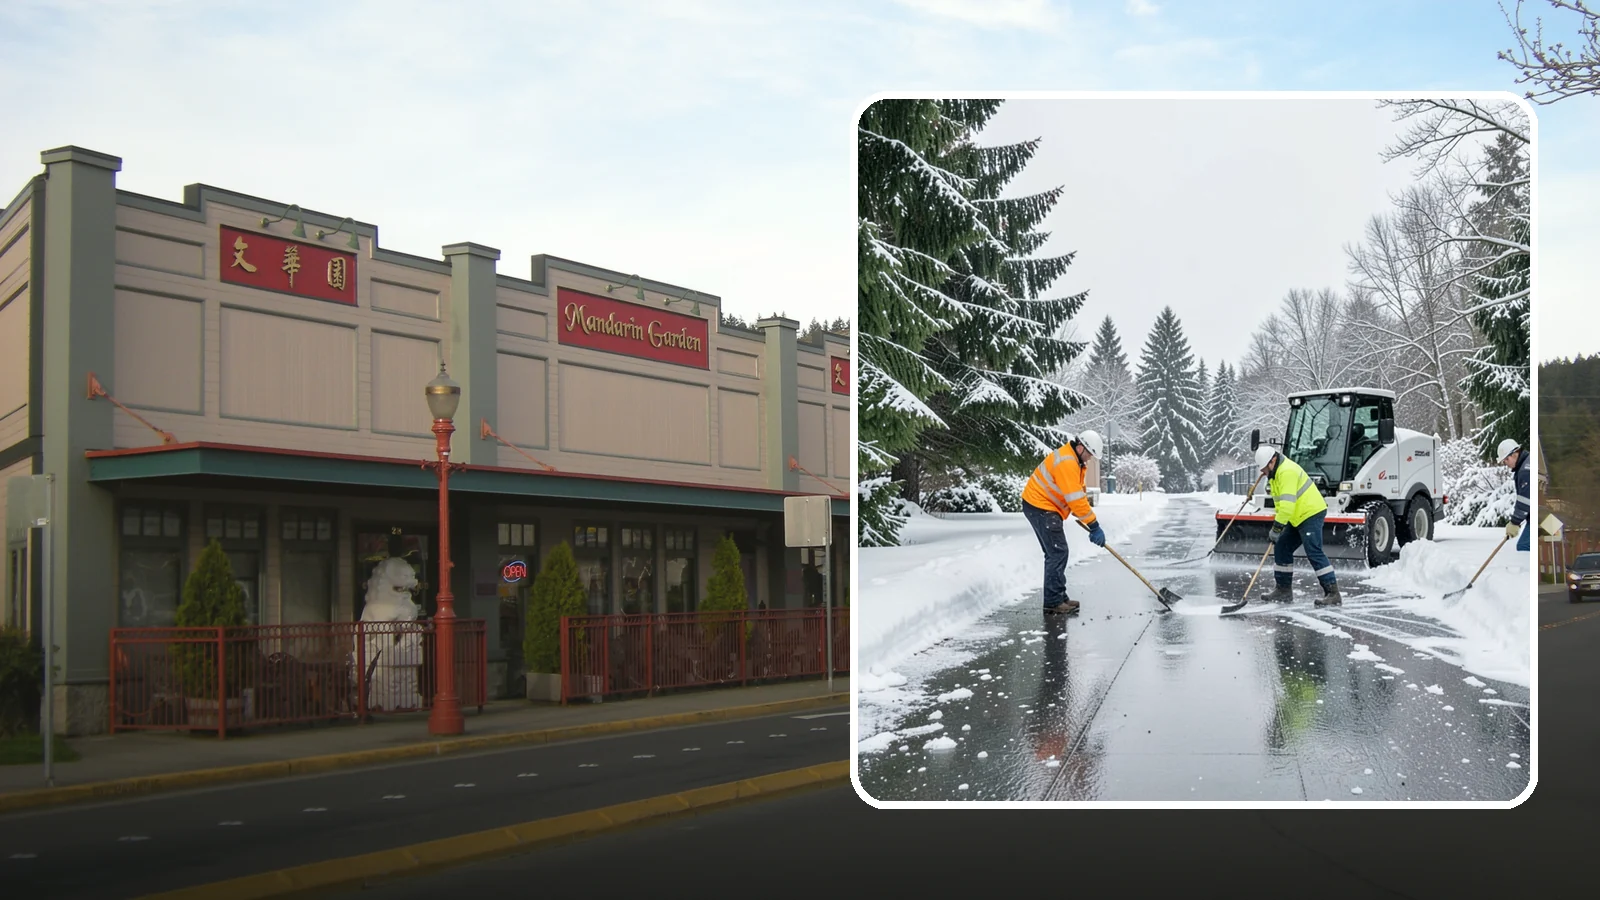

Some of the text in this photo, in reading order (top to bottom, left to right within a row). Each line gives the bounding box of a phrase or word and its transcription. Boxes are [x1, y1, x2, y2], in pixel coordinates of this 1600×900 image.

[231, 235, 346, 291] 文華園
[564, 302, 701, 352] Mandarin Garden
[503, 565, 527, 578] OPEN
